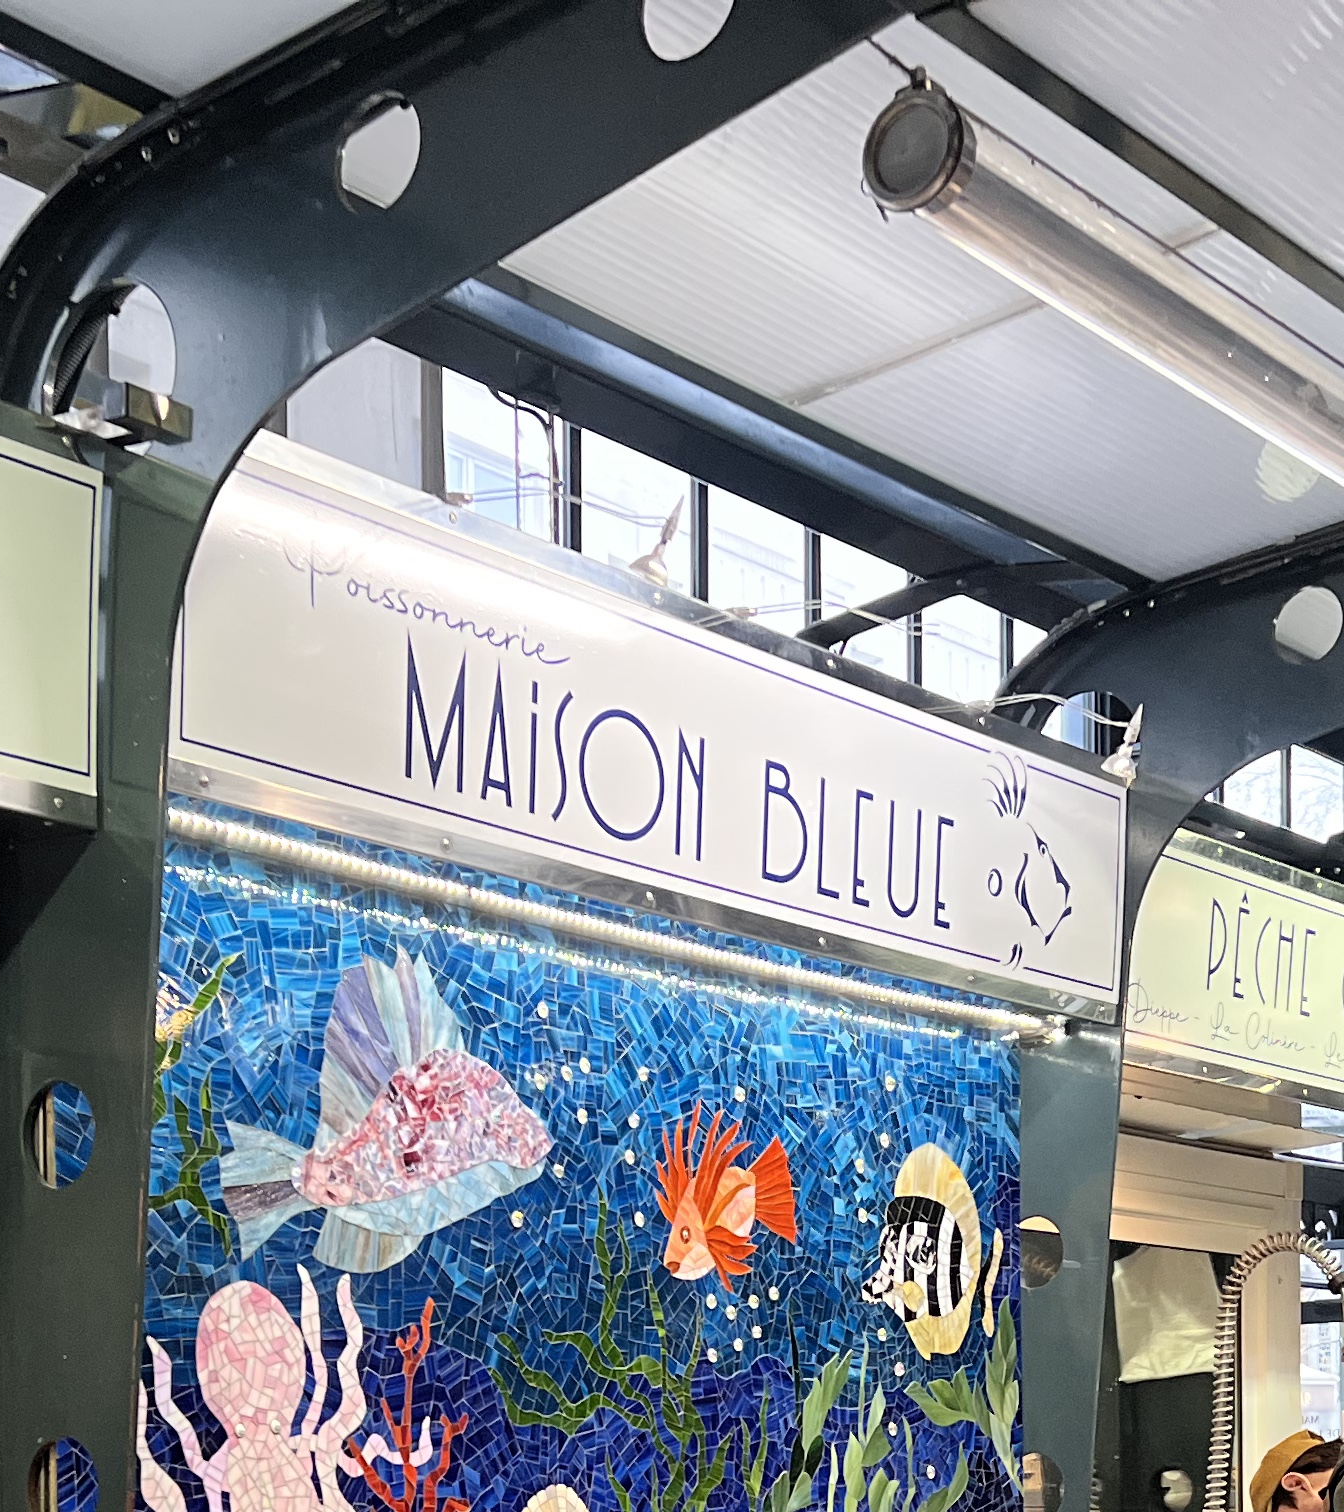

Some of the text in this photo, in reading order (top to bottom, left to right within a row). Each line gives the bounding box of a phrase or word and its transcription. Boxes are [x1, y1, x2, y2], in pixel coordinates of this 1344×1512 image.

[281, 536, 570, 665] Poissonnerie
[762, 759, 954, 929] BLEUE
[1207, 891, 1316, 1017] PÊCHE
